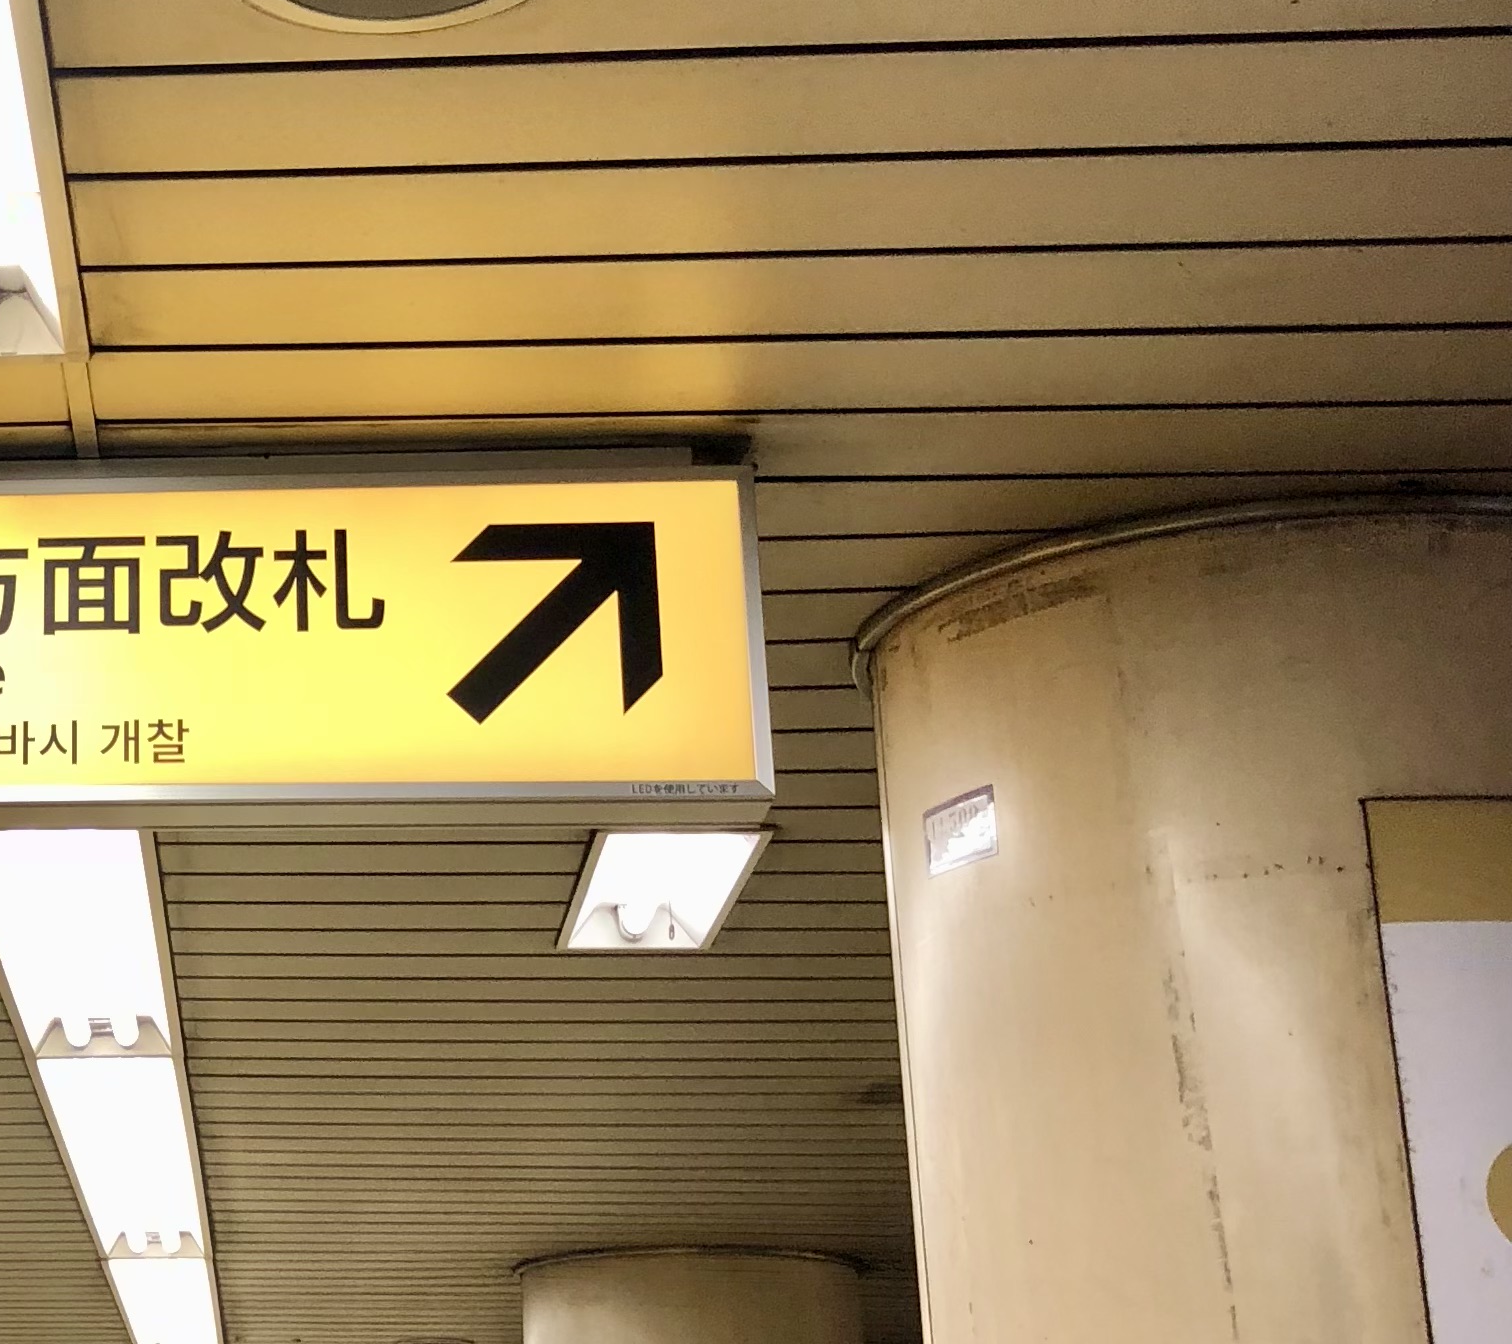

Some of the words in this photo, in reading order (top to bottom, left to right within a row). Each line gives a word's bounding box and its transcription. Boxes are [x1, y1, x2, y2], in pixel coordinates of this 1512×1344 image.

[100, 719, 189, 763] 개찰
[631, 783, 739, 795] LEDを使用しています
